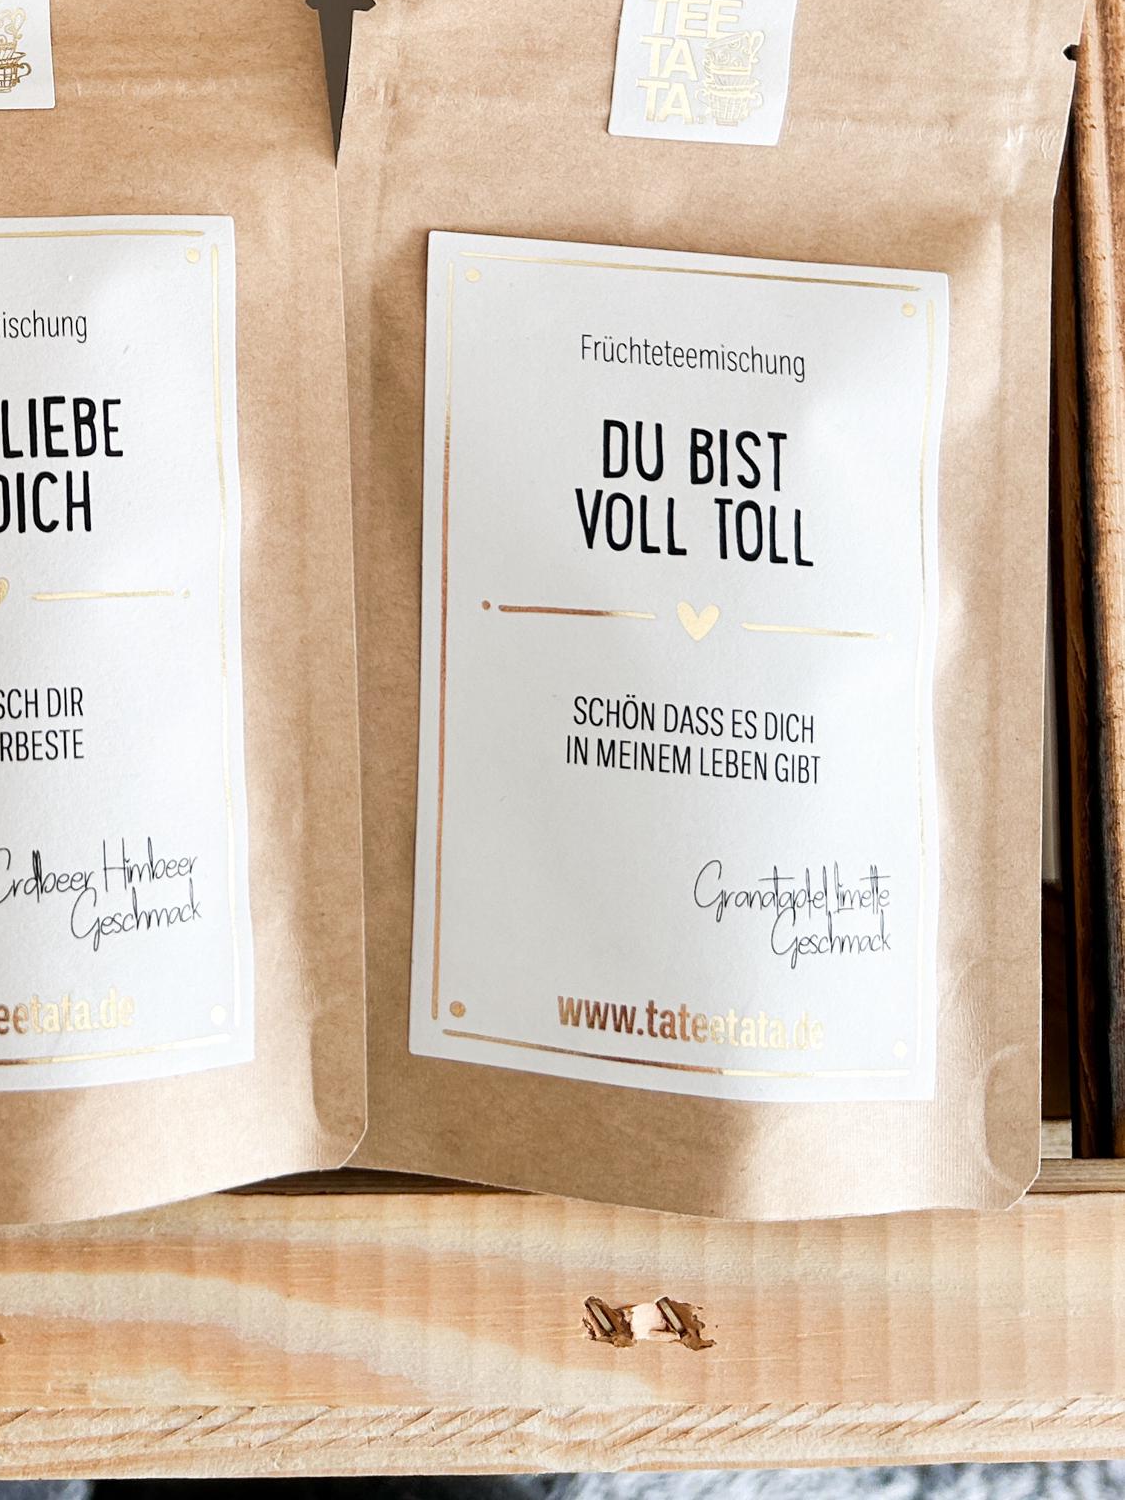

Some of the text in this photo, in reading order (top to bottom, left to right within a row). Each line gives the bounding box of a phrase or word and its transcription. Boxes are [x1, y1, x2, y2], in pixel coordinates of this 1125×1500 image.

[639, 35, 698, 81] TA
[580, 334, 806, 383] Früchteteemischung
[0, 395, 124, 459] LIEBE
[602, 419, 787, 491] DU BIST
[575, 488, 813, 566] VOLL TOLL
[47, 686, 84, 718] DIR
[573, 694, 814, 744] SCHÖN DASS ES DICH
[566, 735, 821, 784] IN MEINEM LEBEN GIBT
[103, 836, 198, 892] Himbeer
[70, 878, 202, 952] Geschmack
[770, 906, 892, 970] Geschmack
[557, 994, 825, 1051] www.tateetata.de
